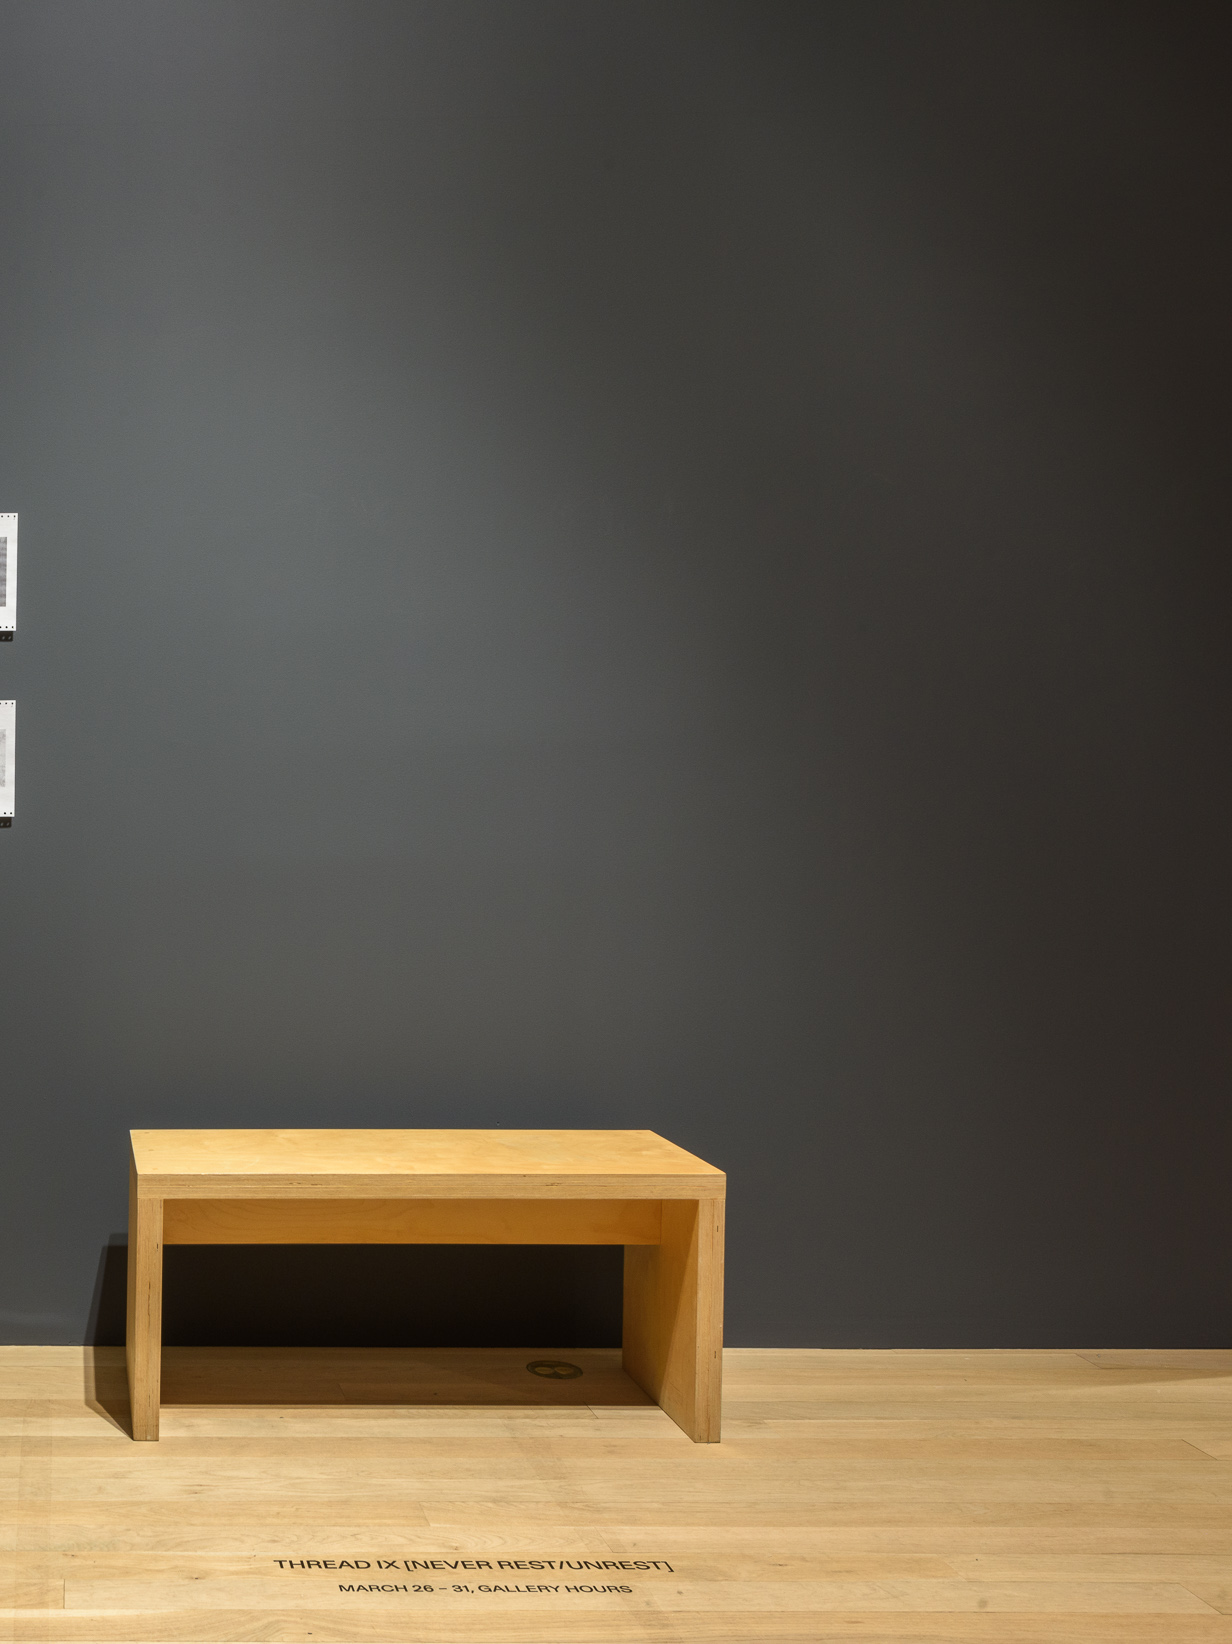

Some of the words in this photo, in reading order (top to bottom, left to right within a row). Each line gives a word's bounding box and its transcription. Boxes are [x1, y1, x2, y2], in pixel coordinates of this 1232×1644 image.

[273, 1559, 372, 1570] THREAD
[376, 1559, 401, 1570] IX
[404, 1560, 494, 1572] [NEVER
[496, 1560, 675, 1573] REST/UNREST]
[338, 1584, 408, 1593] MARCH
[411, 1584, 434, 1593] 26
[452, 1585, 475, 1595] 31,
[477, 1585, 561, 1594] GALLERY
[564, 1585, 633, 1594] HOURS
